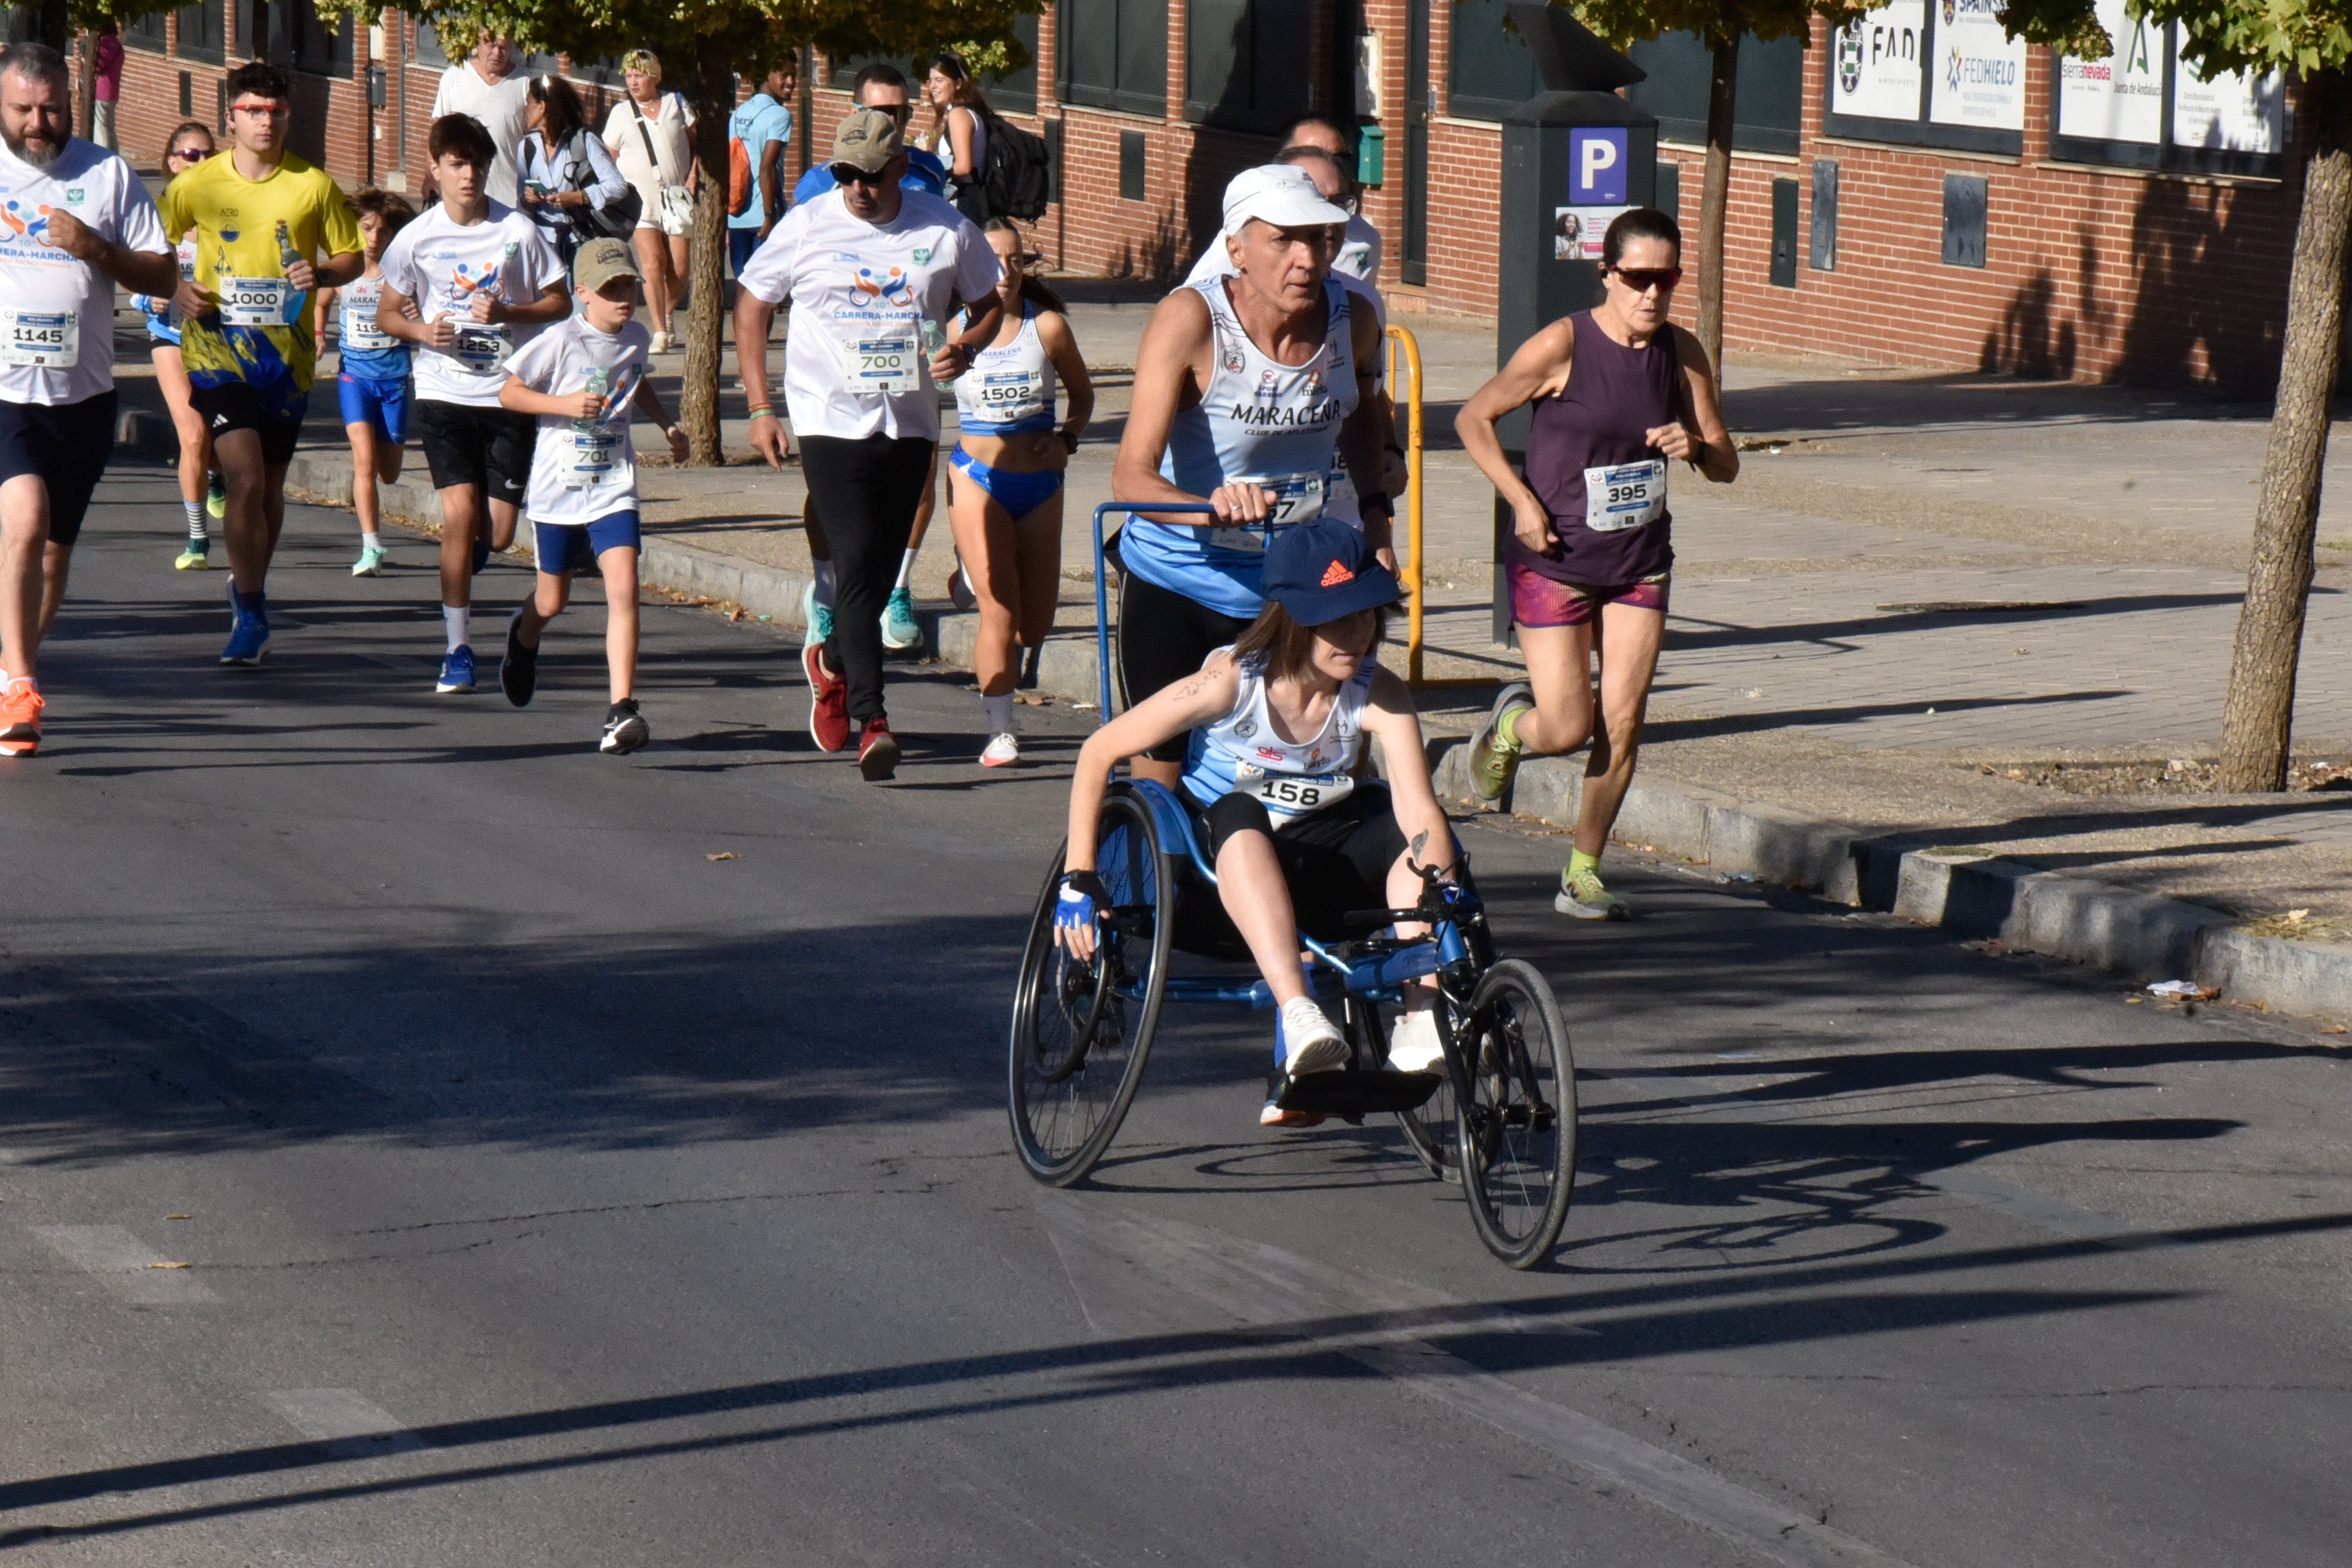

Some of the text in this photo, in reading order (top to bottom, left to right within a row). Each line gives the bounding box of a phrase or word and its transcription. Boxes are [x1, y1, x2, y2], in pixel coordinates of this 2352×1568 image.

[1964, 57, 2016, 85] FEDHIELO
[2062, 63, 2111, 81] sierranevada
[1581, 139, 1616, 189] P
[231, 293, 278, 305] 1000
[13, 328, 63, 344] 1145
[457, 338, 501, 353] 1253
[860, 355, 901, 369] 700
[981, 386, 1030, 400] 1502
[1230, 399, 1341, 425] MARACENA
[578, 450, 609, 464] 701
[1608, 483, 1647, 503] 395
[1321, 570, 1355, 587] adidas
[1261, 780, 1320, 806] 158
